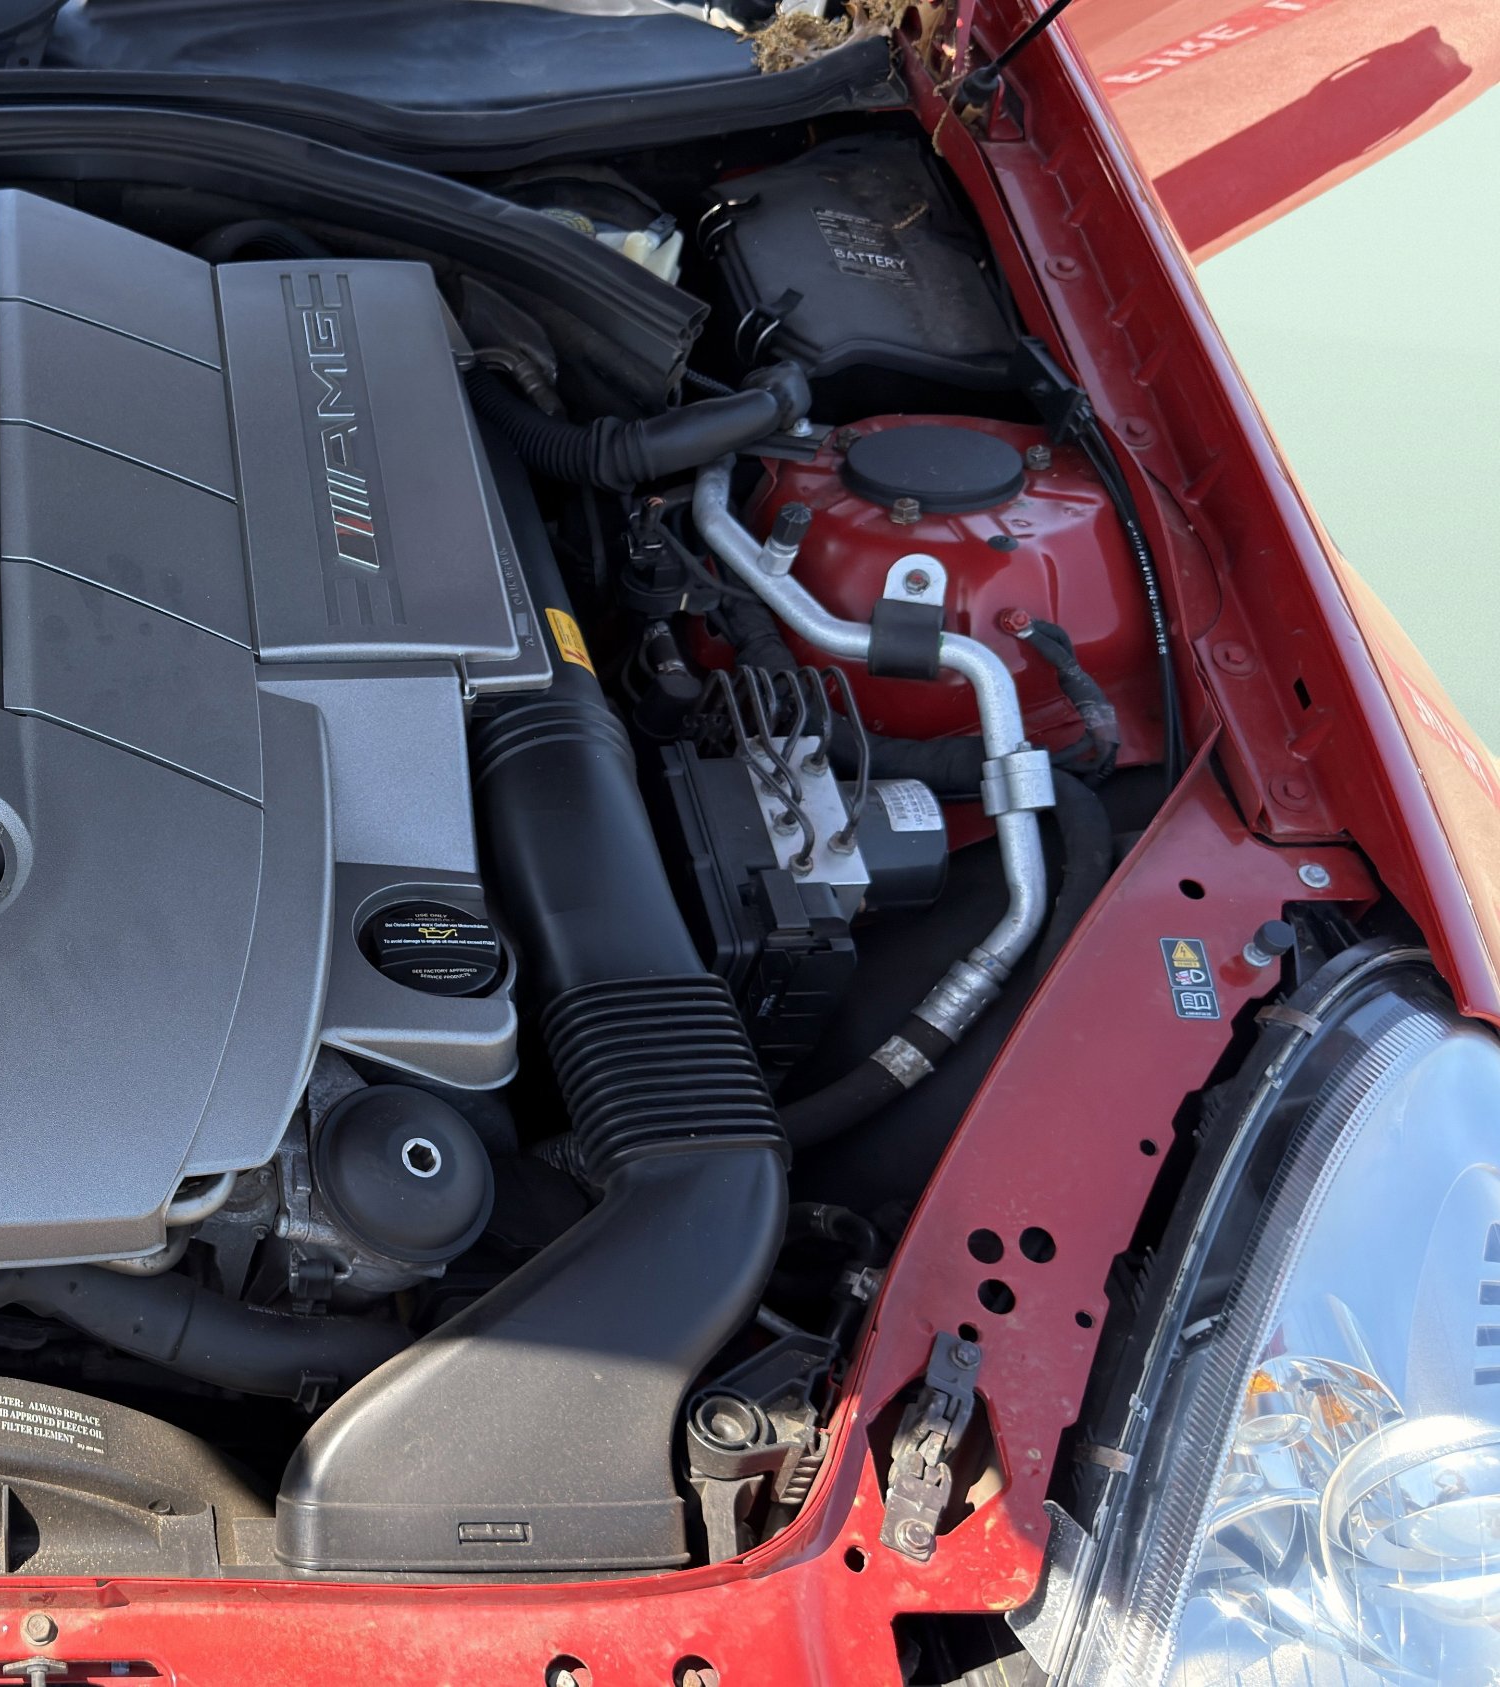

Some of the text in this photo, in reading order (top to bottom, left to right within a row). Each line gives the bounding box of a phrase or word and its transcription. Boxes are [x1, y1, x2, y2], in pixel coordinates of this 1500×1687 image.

[833, 248, 907, 270] BATTERY
[443, 972, 471, 980] PRODUCTS
[10, 1410, 55, 1427] APPROVED
[56, 1420, 89, 1435] FLEECE
[89, 1430, 105, 1440] OIL
[29, 1401, 62, 1416] ALWAYS
[63, 1409, 101, 1427] REPLACE
[1, 1421, 75, 1444] FILTER ELEMENT
